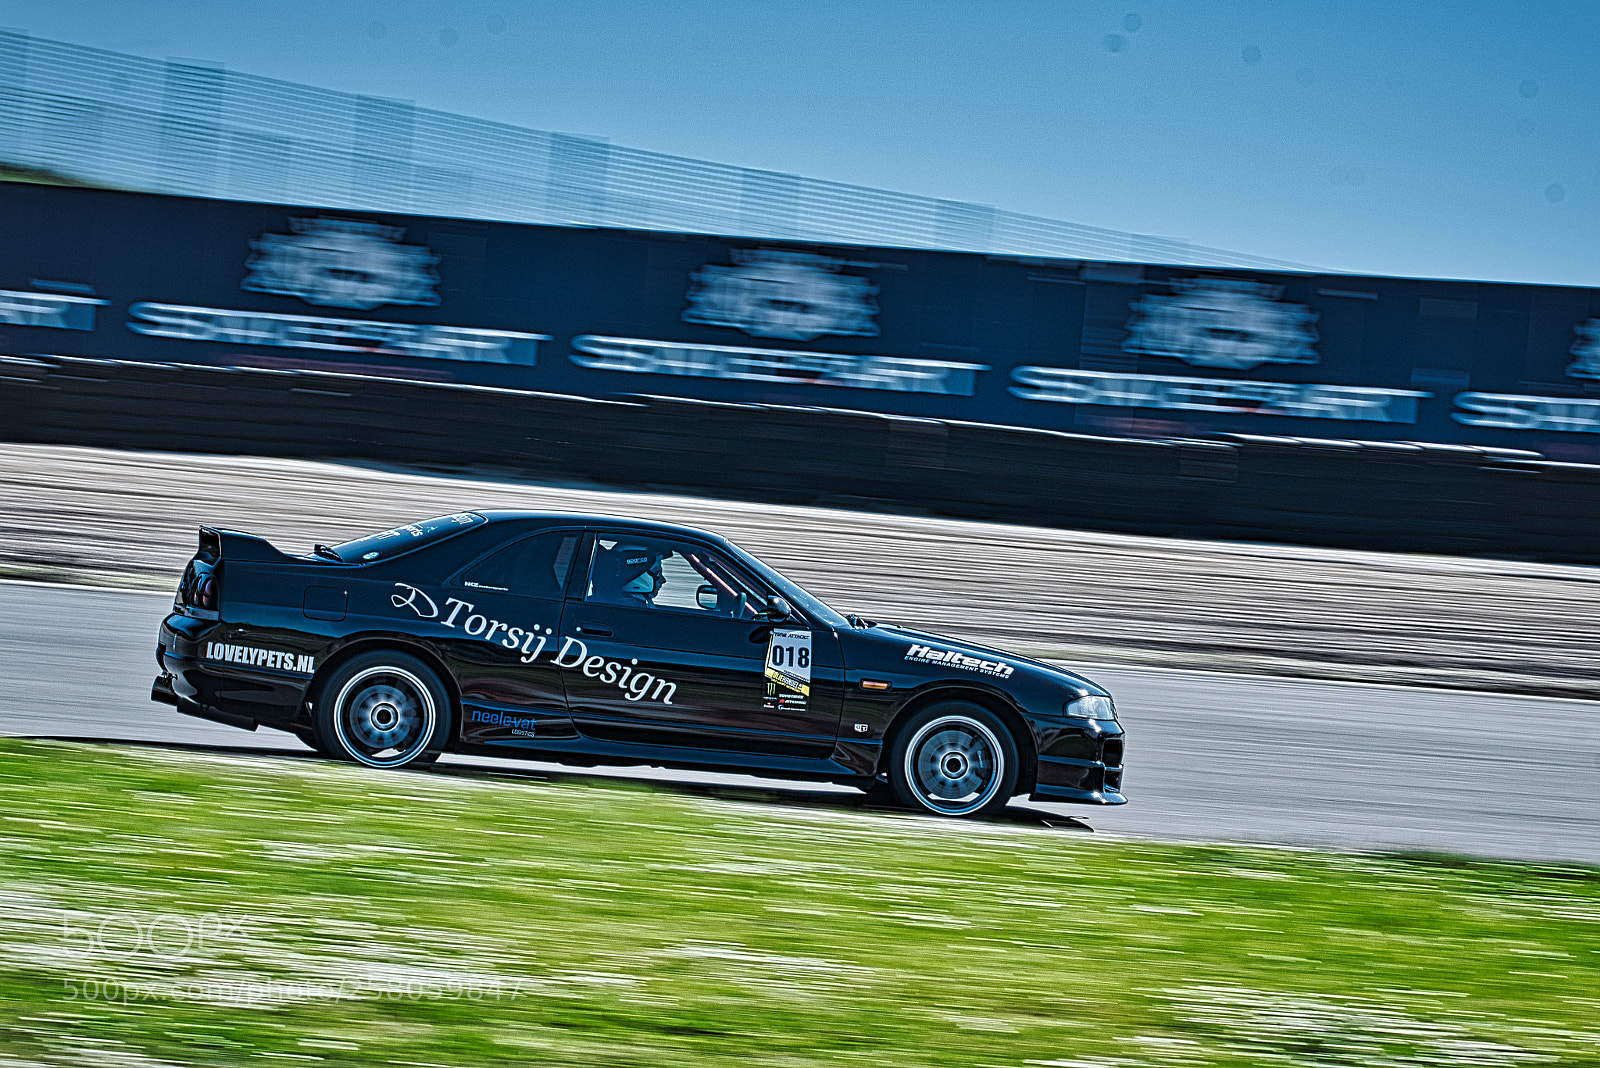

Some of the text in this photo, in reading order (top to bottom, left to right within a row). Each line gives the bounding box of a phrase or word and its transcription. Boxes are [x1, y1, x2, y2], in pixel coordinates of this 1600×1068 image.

[206, 641, 315, 674] LOVELYPETS.NL
[440, 597, 553, 663] Torsij
[550, 635, 678, 705] Design
[772, 645, 810, 668] 018
[906, 644, 1015, 676] Haltech
[903, 655, 1010, 679] ENGINE MANAGEMENT SYSTEMS
[472, 710, 537, 731] neelevat
[511, 728, 535, 738] LOGISTICS
